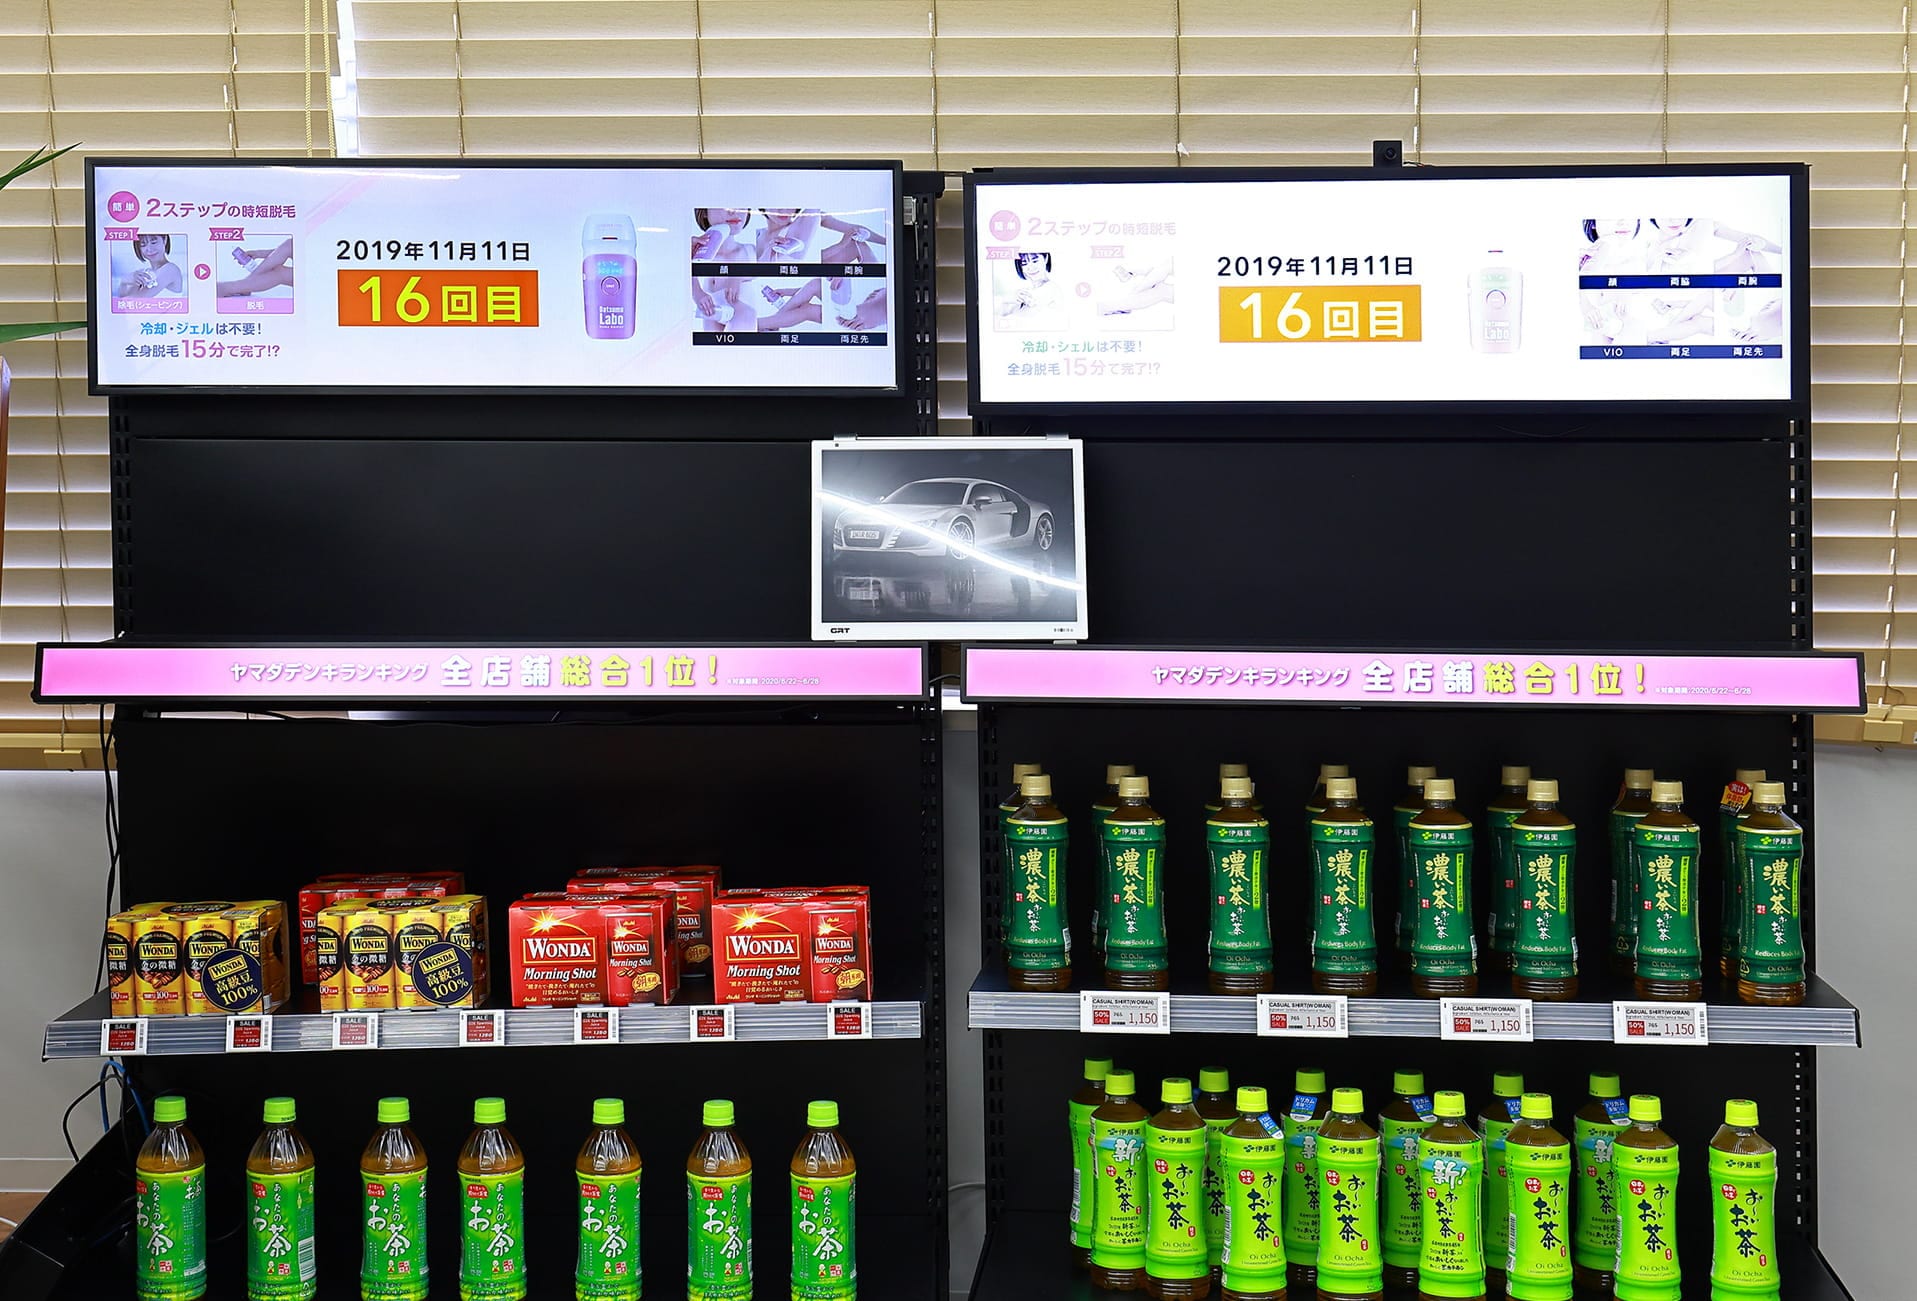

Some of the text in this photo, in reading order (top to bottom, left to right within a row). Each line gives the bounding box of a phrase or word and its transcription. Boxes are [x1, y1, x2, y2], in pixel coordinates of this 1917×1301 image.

[146, 198, 297, 219] 2ステップの時短脱毛
[336, 240, 531, 263] 2019年11月11日
[1217, 255, 1414, 277] 2019年11月11日
[246, 301, 265, 311] 脱毛
[358, 275, 522, 324] 16回目
[599, 313, 625, 326] Labo
[1239, 291, 1405, 339] 16回目
[715, 334, 736, 344] VIO
[780, 334, 800, 344] 両足
[840, 334, 870, 344] 両足先
[1603, 348, 1624, 357] VIO
[1669, 347, 1691, 358] 両足
[1733, 347, 1764, 357] 両足先
[229, 661, 430, 684] ヤマダデンキランキング
[1150, 665, 1351, 689] ヤマダデンキランキング
[1019, 848, 1046, 904] 濃い茶
[1115, 848, 1145, 904] 濃い茶
[1221, 849, 1250, 906] 濃い茶
[1327, 849, 1357, 906] 濃い茶
[1425, 852, 1455, 910] 濃い茶
[1528, 854, 1557, 911] 濃い茶
[1648, 854, 1678, 912] 濃い茶
[1762, 858, 1791, 915] 濃い茶
[141, 943, 174, 956] WONDA
[352, 938, 385, 949] WONDA
[526, 938, 592, 959] WONDA
[613, 940, 647, 953] WONDA
[729, 934, 795, 956] WONDA
[817, 937, 851, 950] WONDA
[140, 960, 177, 972] 金の微糖
[210, 960, 243, 976] WONDA
[351, 955, 388, 965] 金の微糖
[422, 952, 453, 969] WONDA
[609, 958, 653, 968] Morning Shot
[813, 954, 857, 965] Morning Shot
[215, 971, 253, 994] 高級豆
[426, 963, 465, 988] 高級豆
[523, 967, 598, 982] Morning Shot
[726, 964, 801, 979] Morning Shot
[221, 984, 259, 1006] 100%
[432, 977, 469, 999] 100%
[1129, 1013, 1158, 1024] 1,150
[1306, 1016, 1336, 1028] 1,150
[1491, 1020, 1520, 1033] 1,150
[1664, 1023, 1695, 1036] 1,150
[1431, 1158, 1467, 1190] 新!
[152, 1181, 161, 1221] あなたの
[273, 1183, 282, 1222] あなたの
[391, 1183, 401, 1222] あなたの
[495, 1183, 505, 1222] あなたの
[608, 1184, 618, 1223] あなたの
[729, 1185, 738, 1224] あなたの
[822, 1186, 832, 1225] あなたの
